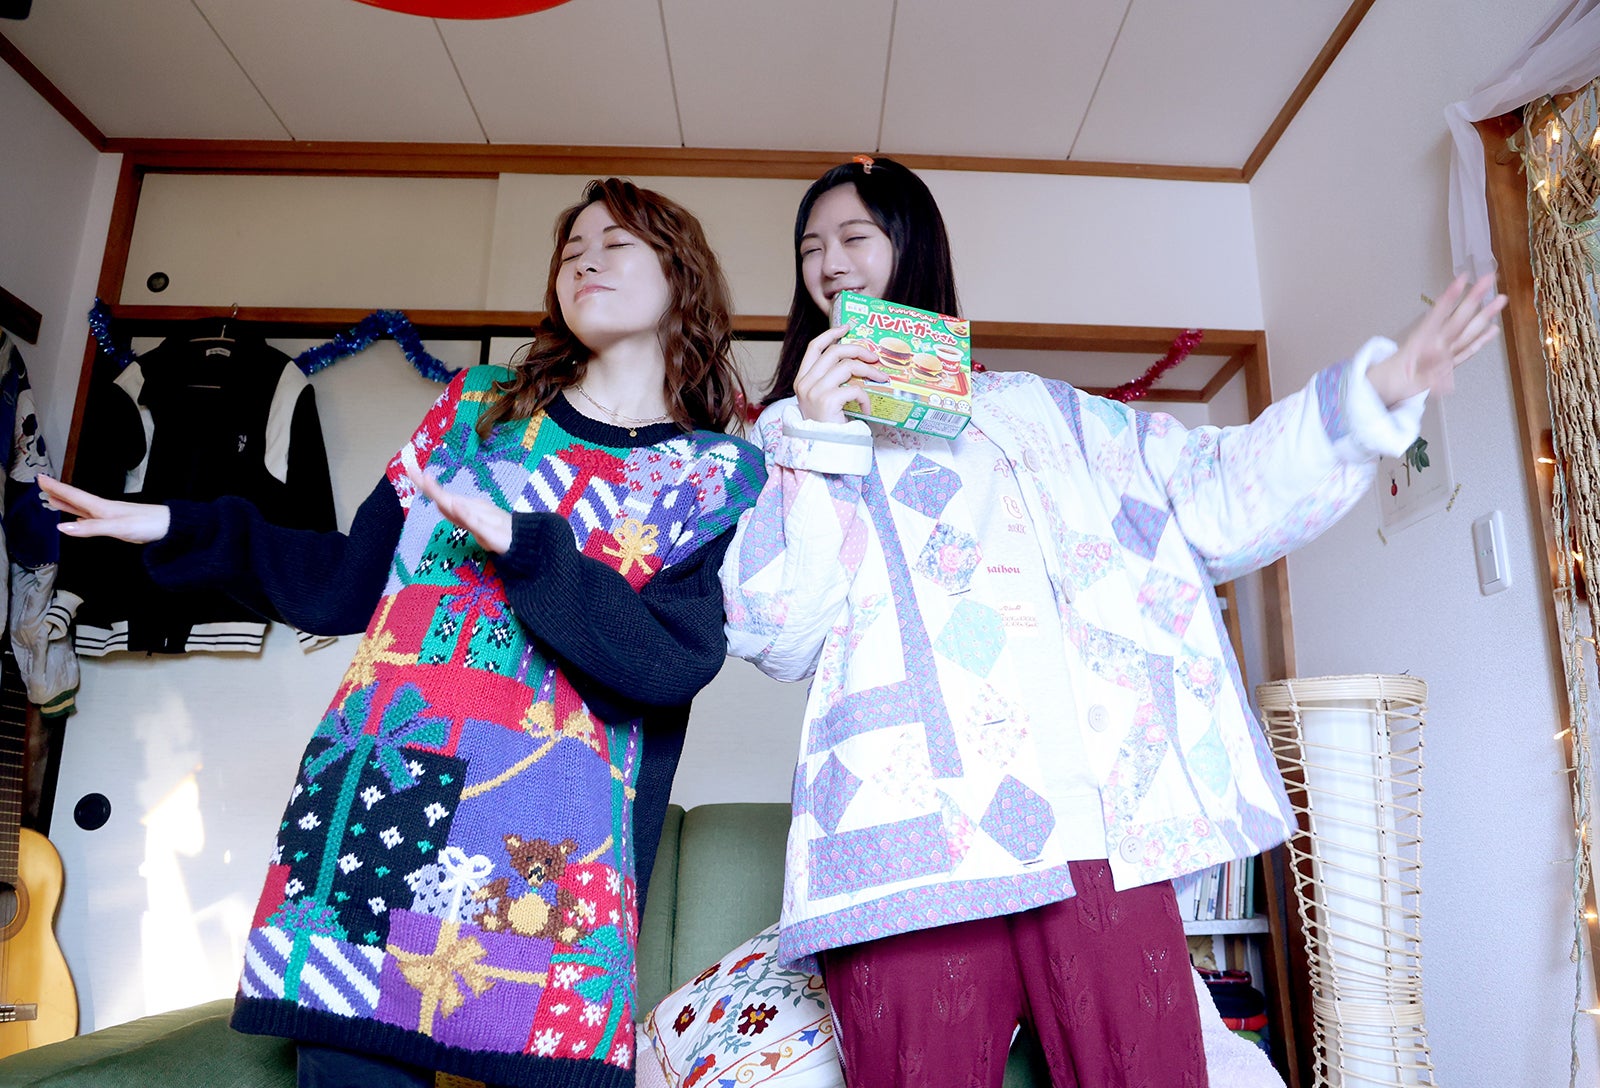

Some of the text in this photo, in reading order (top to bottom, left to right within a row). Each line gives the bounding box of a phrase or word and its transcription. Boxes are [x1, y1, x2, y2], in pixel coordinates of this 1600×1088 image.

[867, 312, 957, 345] ハンバーガーやさん
